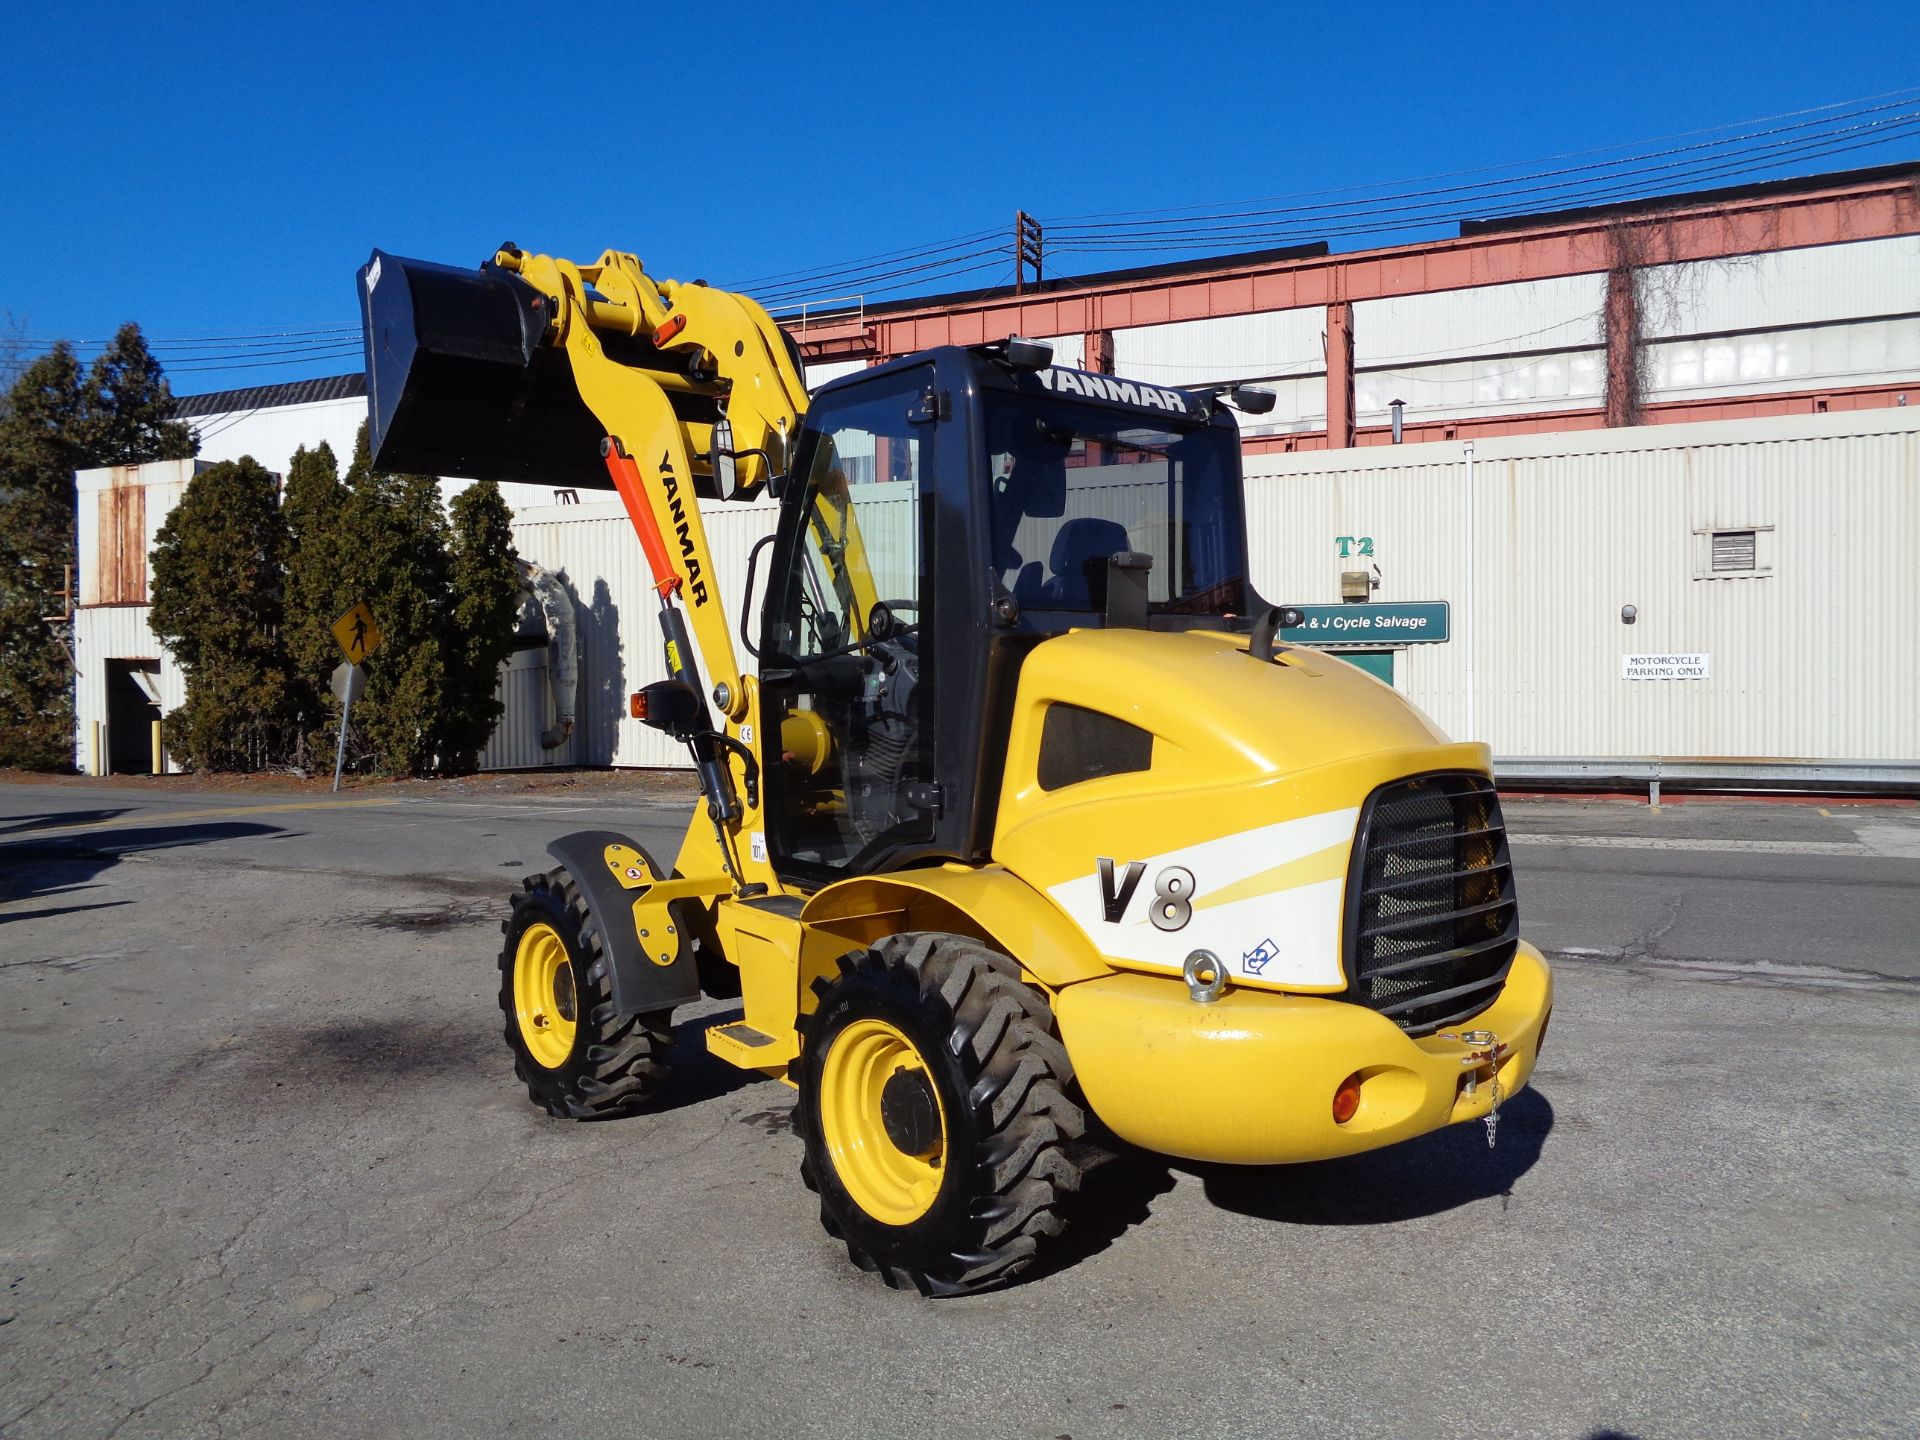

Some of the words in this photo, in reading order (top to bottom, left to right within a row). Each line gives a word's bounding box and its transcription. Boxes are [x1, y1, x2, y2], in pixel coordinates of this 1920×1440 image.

[1034, 368, 1187, 413] YANMAR
[658, 449, 708, 608] YANMAR
[1335, 536, 1374, 558] T2
[1309, 617, 1319, 629] &
[1321, 617, 1331, 629] J
[1333, 616, 1371, 631] Cycle
[1374, 615, 1427, 630] Salvage
[1627, 668, 1674, 676] PARKING
[1677, 667, 1704, 676] ONLY
[1630, 657, 1701, 665] MOTORCYCLE
[1097, 857, 1196, 932] V8
